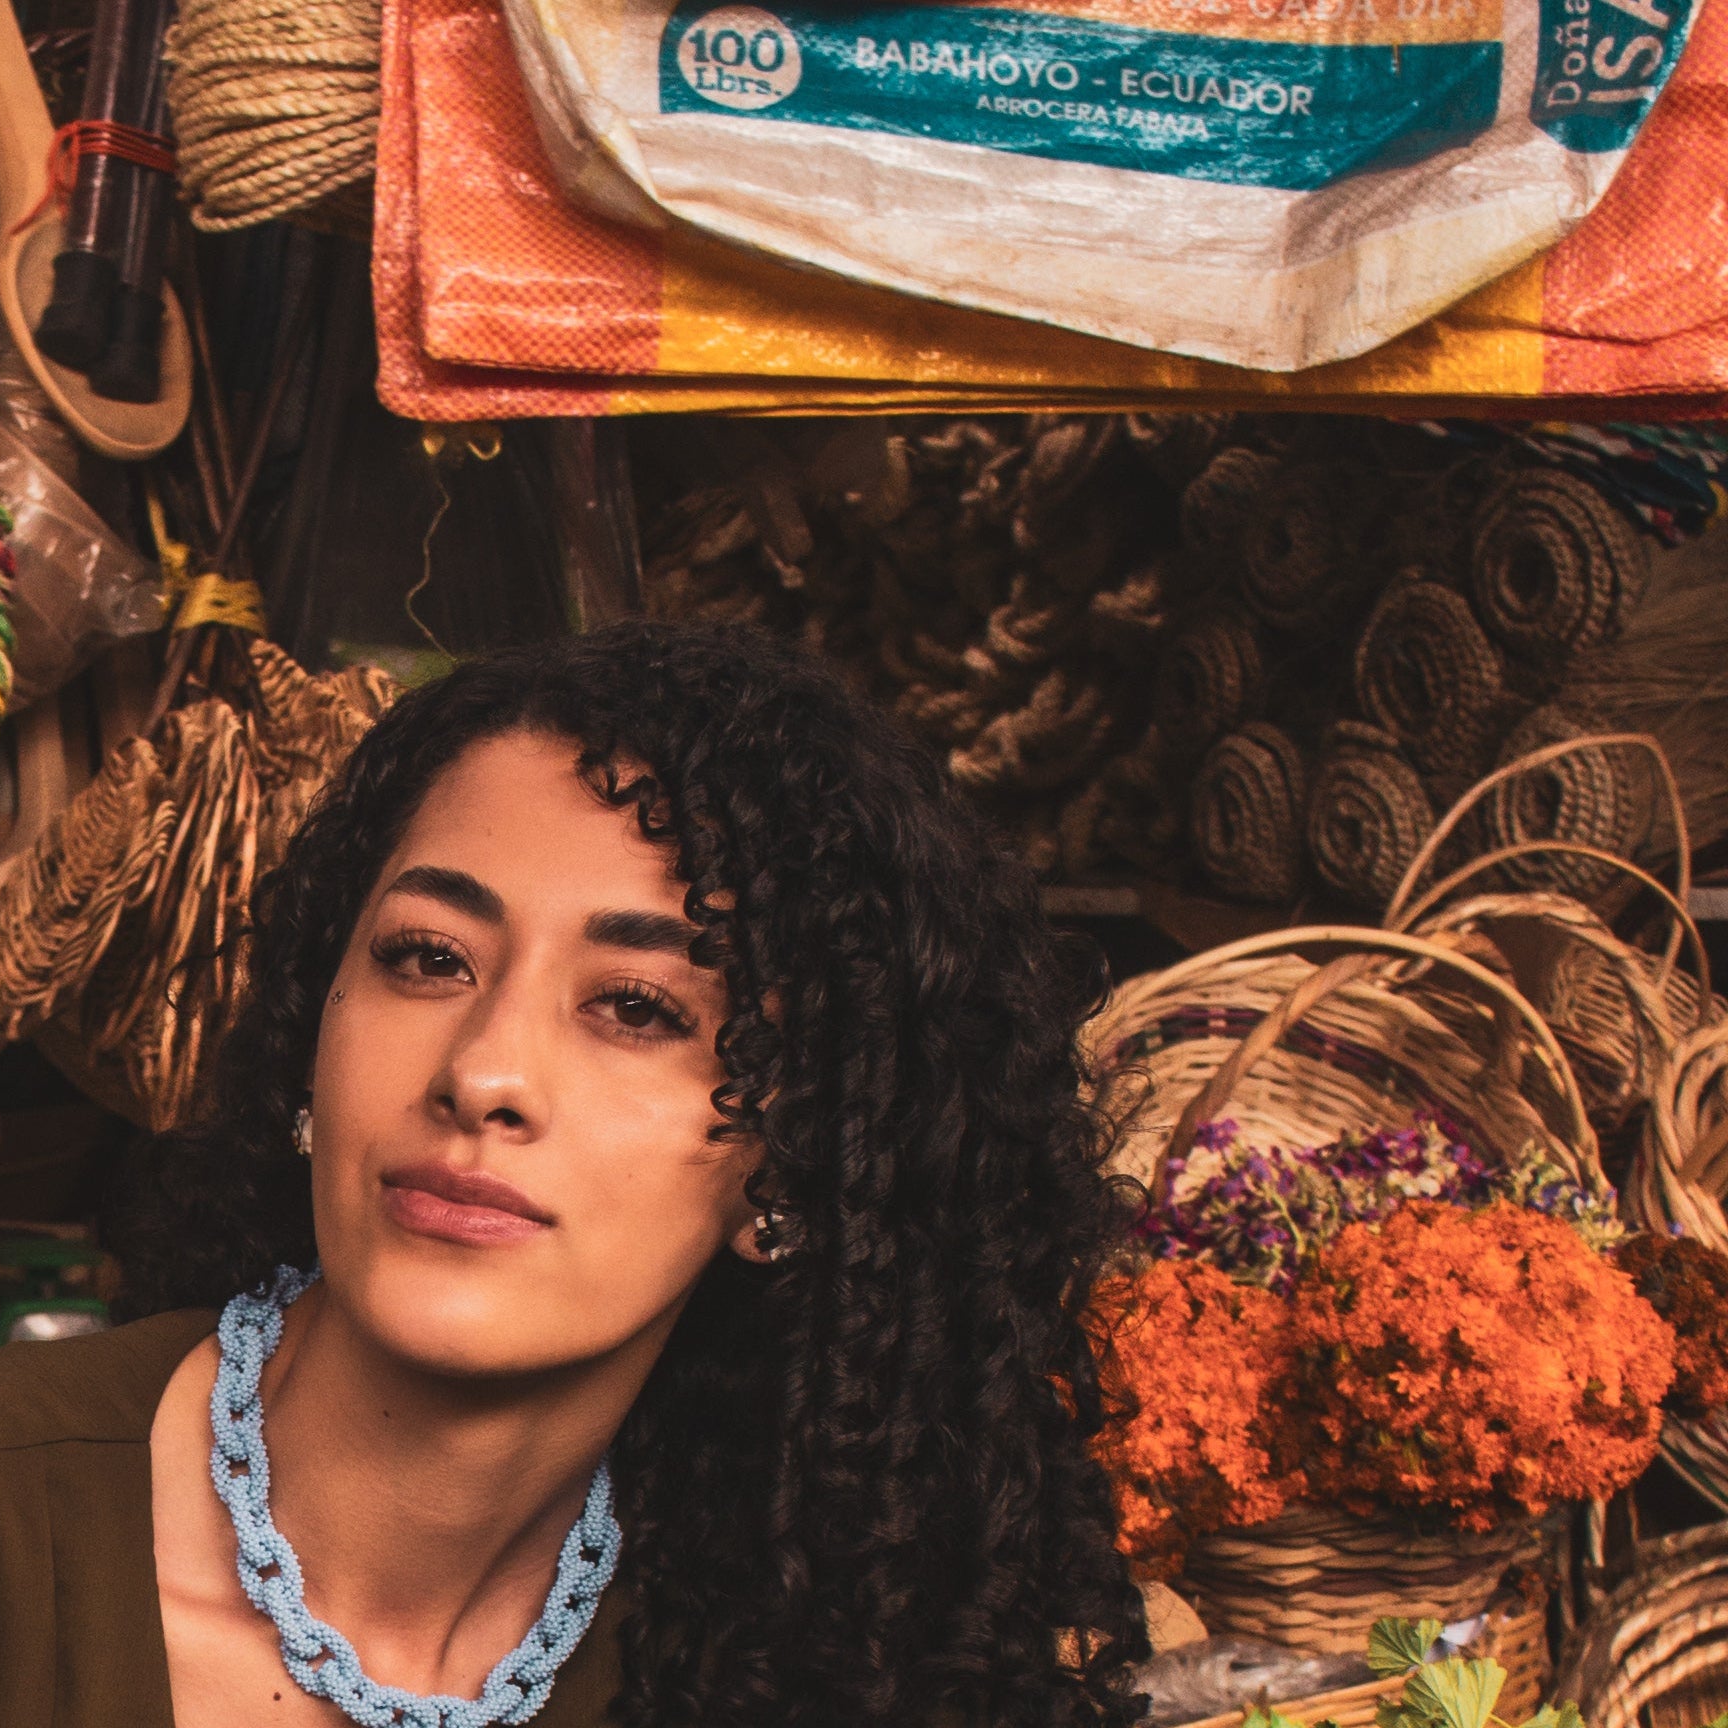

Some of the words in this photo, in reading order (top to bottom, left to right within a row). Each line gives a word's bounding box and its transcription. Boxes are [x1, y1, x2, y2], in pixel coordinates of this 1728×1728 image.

[687, 27, 786, 73] 100
[694, 65, 783, 97] Lbrs.
[855, 36, 1080, 91] BABAHOYO
[1120, 67, 1314, 116] ECUADOR
[976, 93, 1110, 125] ARROCERA
